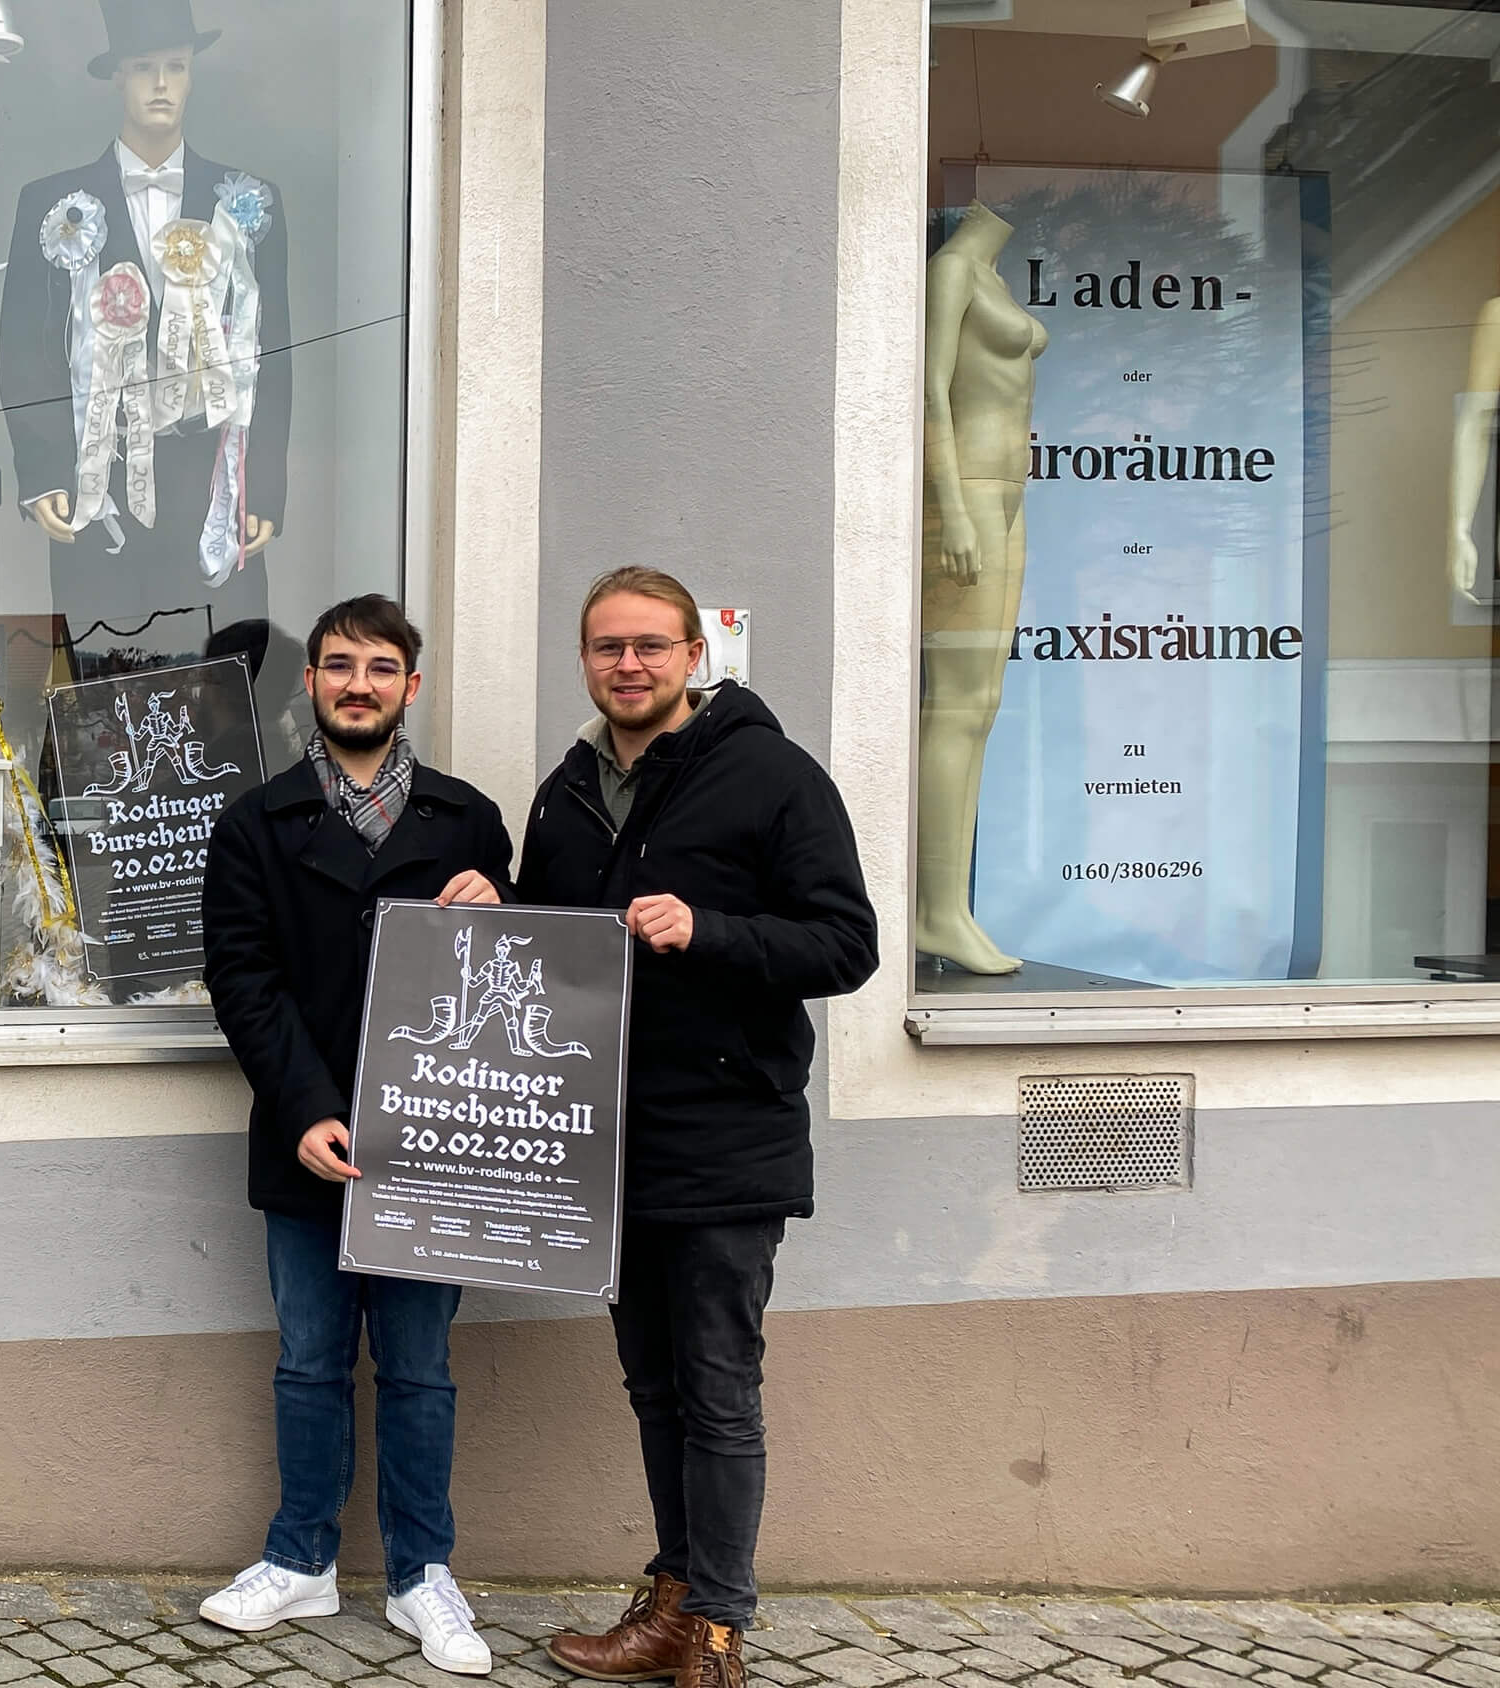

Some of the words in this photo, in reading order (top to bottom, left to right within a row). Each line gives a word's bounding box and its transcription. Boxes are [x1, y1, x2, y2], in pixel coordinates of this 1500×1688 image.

[1026, 258, 1252, 311] Laden-
[1123, 369, 1153, 383] oder
[209, 378, 227, 411] 2017
[131, 464, 149, 517] 2016
[1123, 542, 1154, 555] oder
[1123, 743, 1146, 758] zu
[1084, 778, 1183, 795] vermieten
[106, 791, 225, 825] Rodinger
[1062, 860, 1204, 884] 0160/3806296
[410, 1052, 565, 1102] Rodinger
[379, 1083, 595, 1135] Burschenball
[400, 1125, 566, 1166] 20.02.2023
[423, 1160, 543, 1183] www.bv-roding.de
